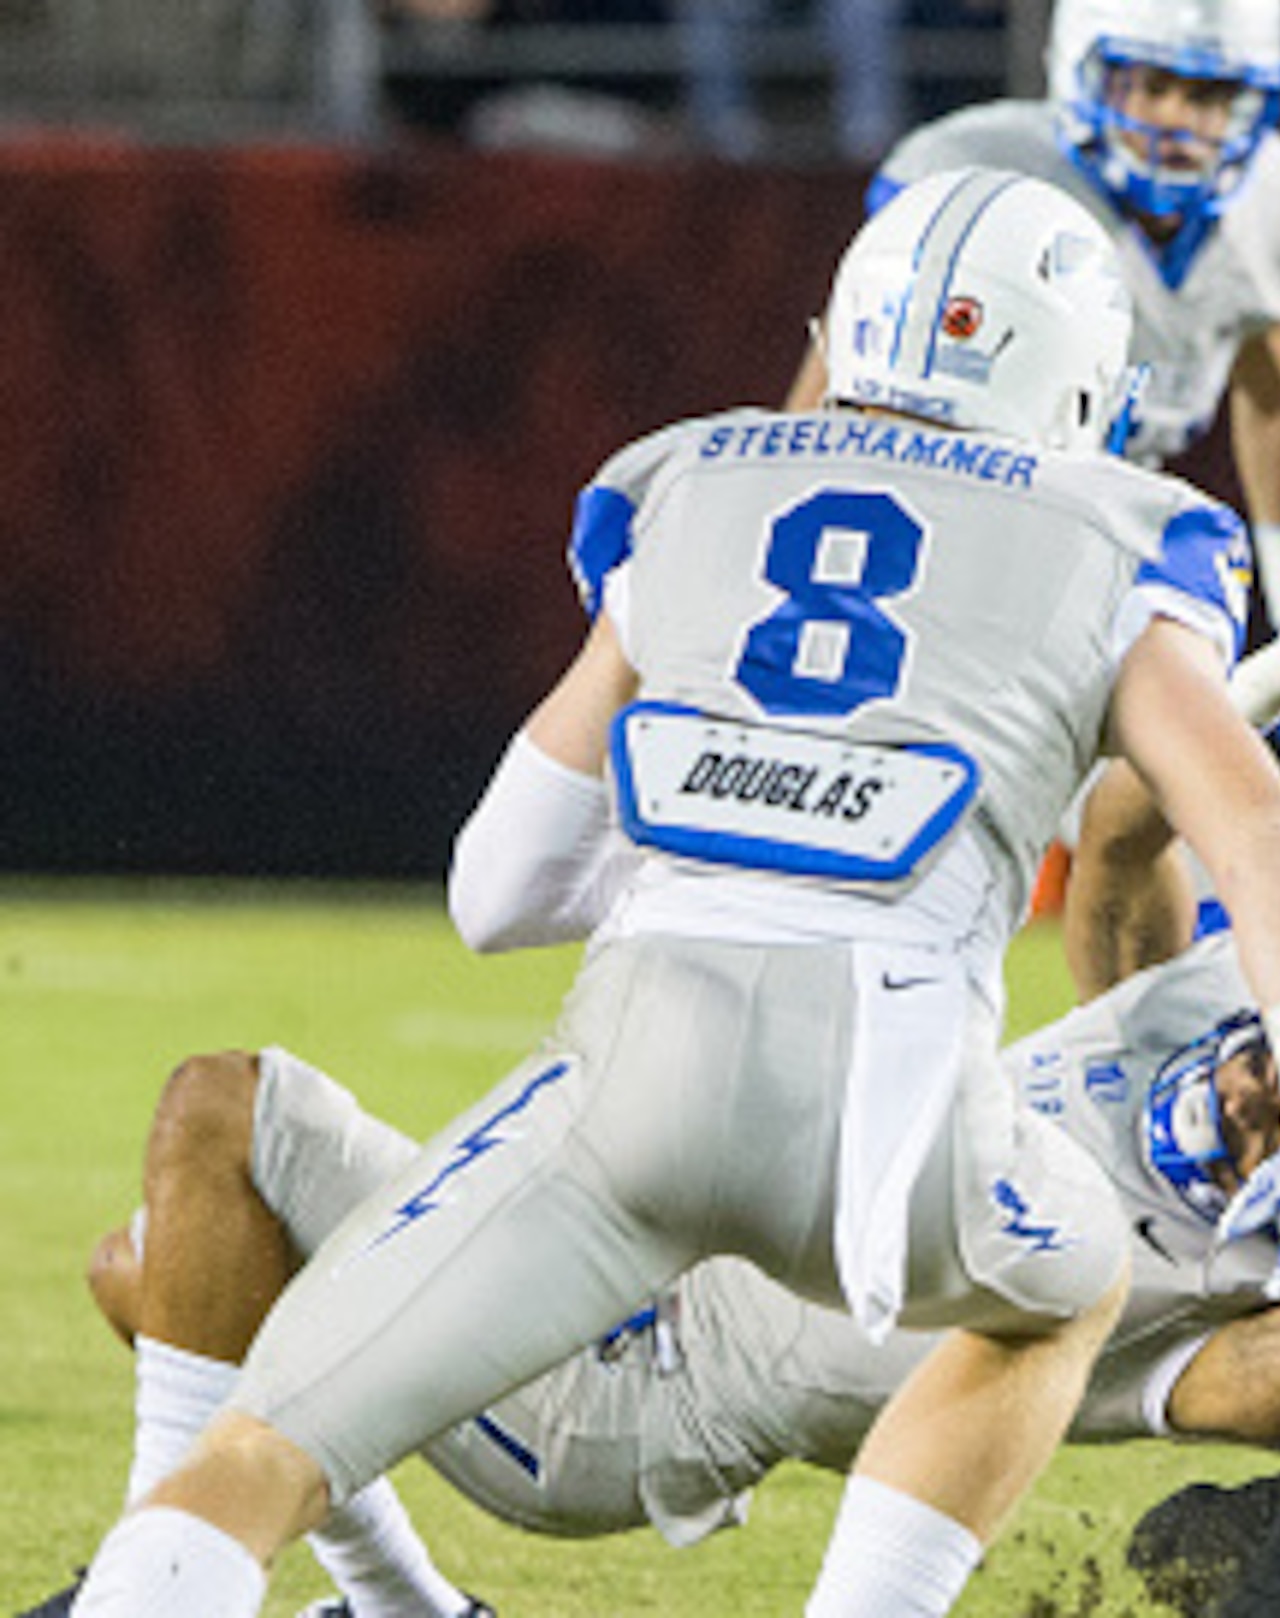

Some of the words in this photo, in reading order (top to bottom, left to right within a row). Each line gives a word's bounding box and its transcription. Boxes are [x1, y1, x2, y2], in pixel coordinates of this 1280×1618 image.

[700, 420, 1040, 490] STEELHAMMER
[731, 486, 928, 720] 8
[678, 751, 885, 823] DOUGLAS
